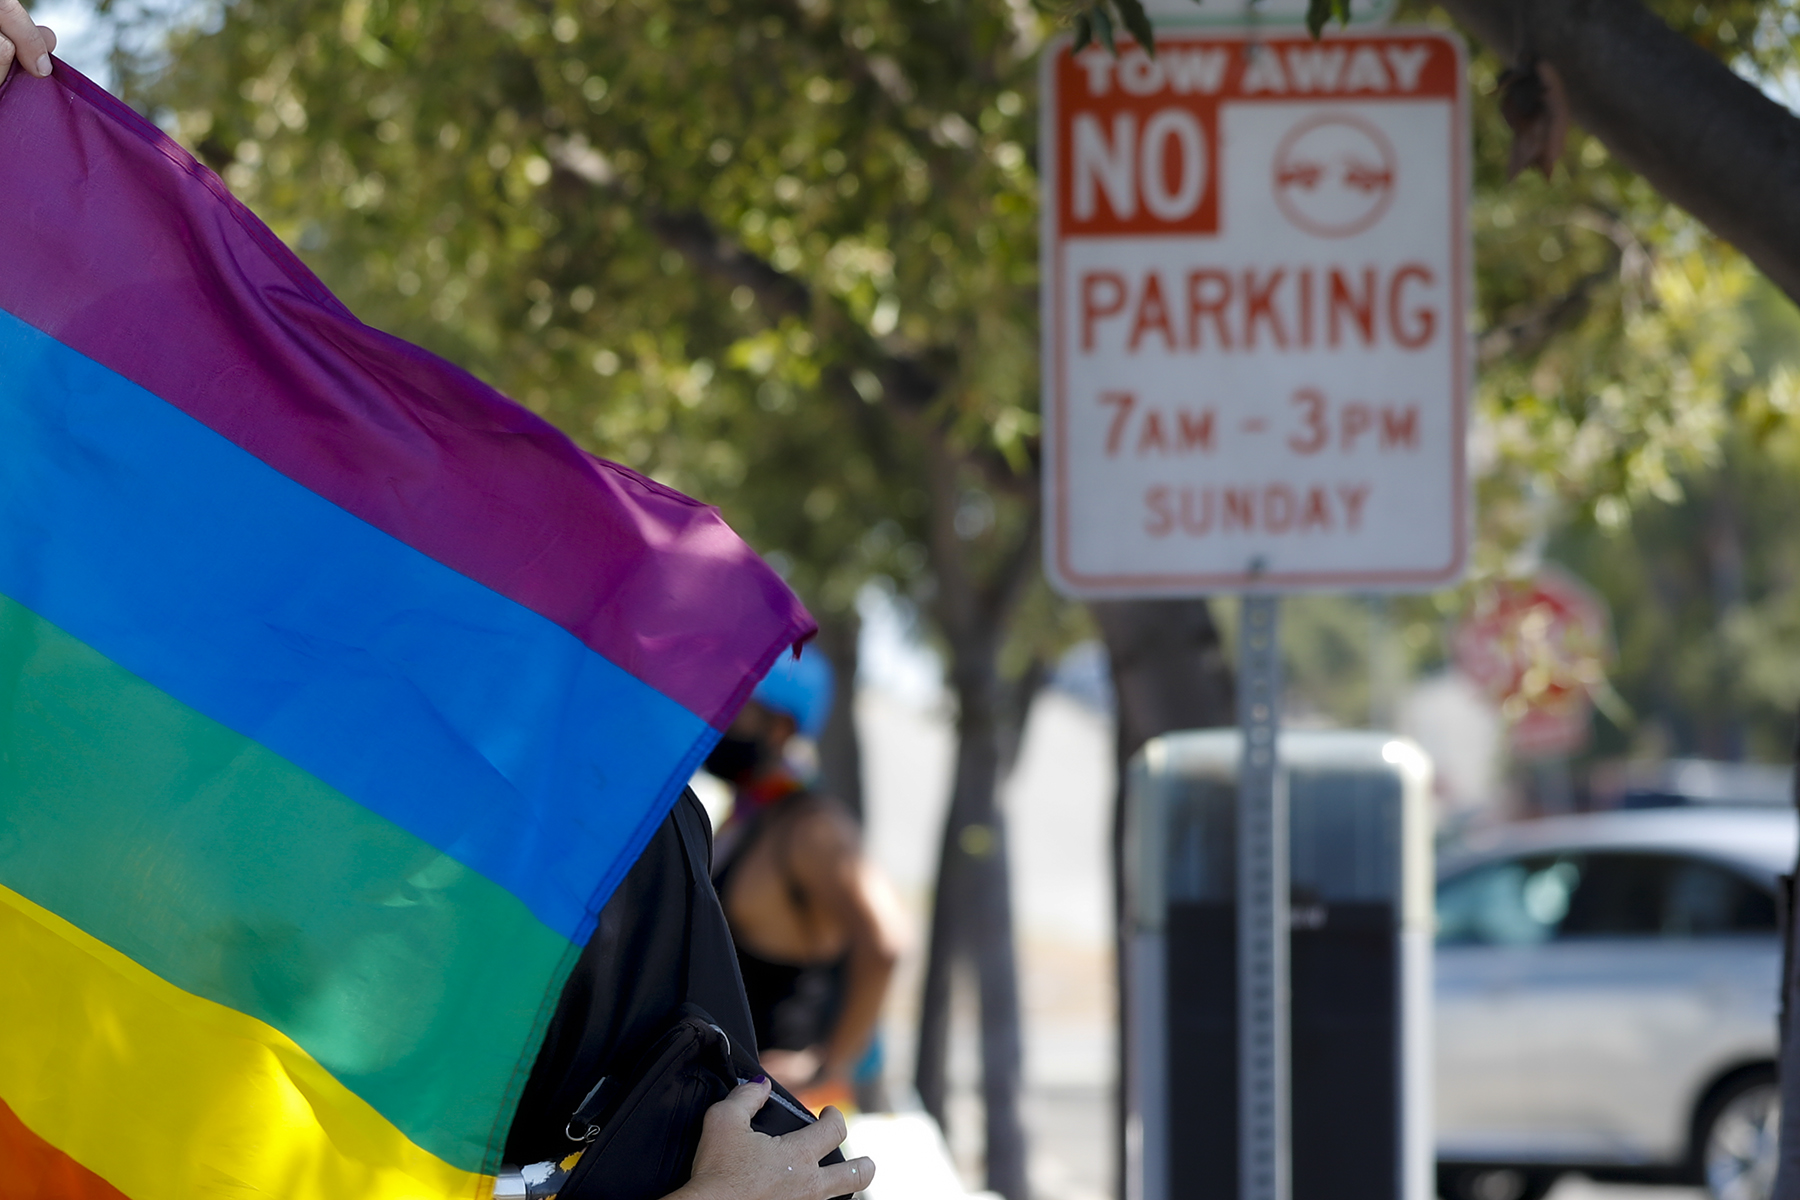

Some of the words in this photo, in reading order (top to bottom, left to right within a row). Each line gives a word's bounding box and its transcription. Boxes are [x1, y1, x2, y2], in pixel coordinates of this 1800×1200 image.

[1076, 45, 1227, 96] TOW
[1242, 43, 1430, 94] AWAY
[1071, 108, 1209, 223] NO
[1079, 263, 1438, 354] PARKING
[1144, 482, 1372, 537] SUNDAY
